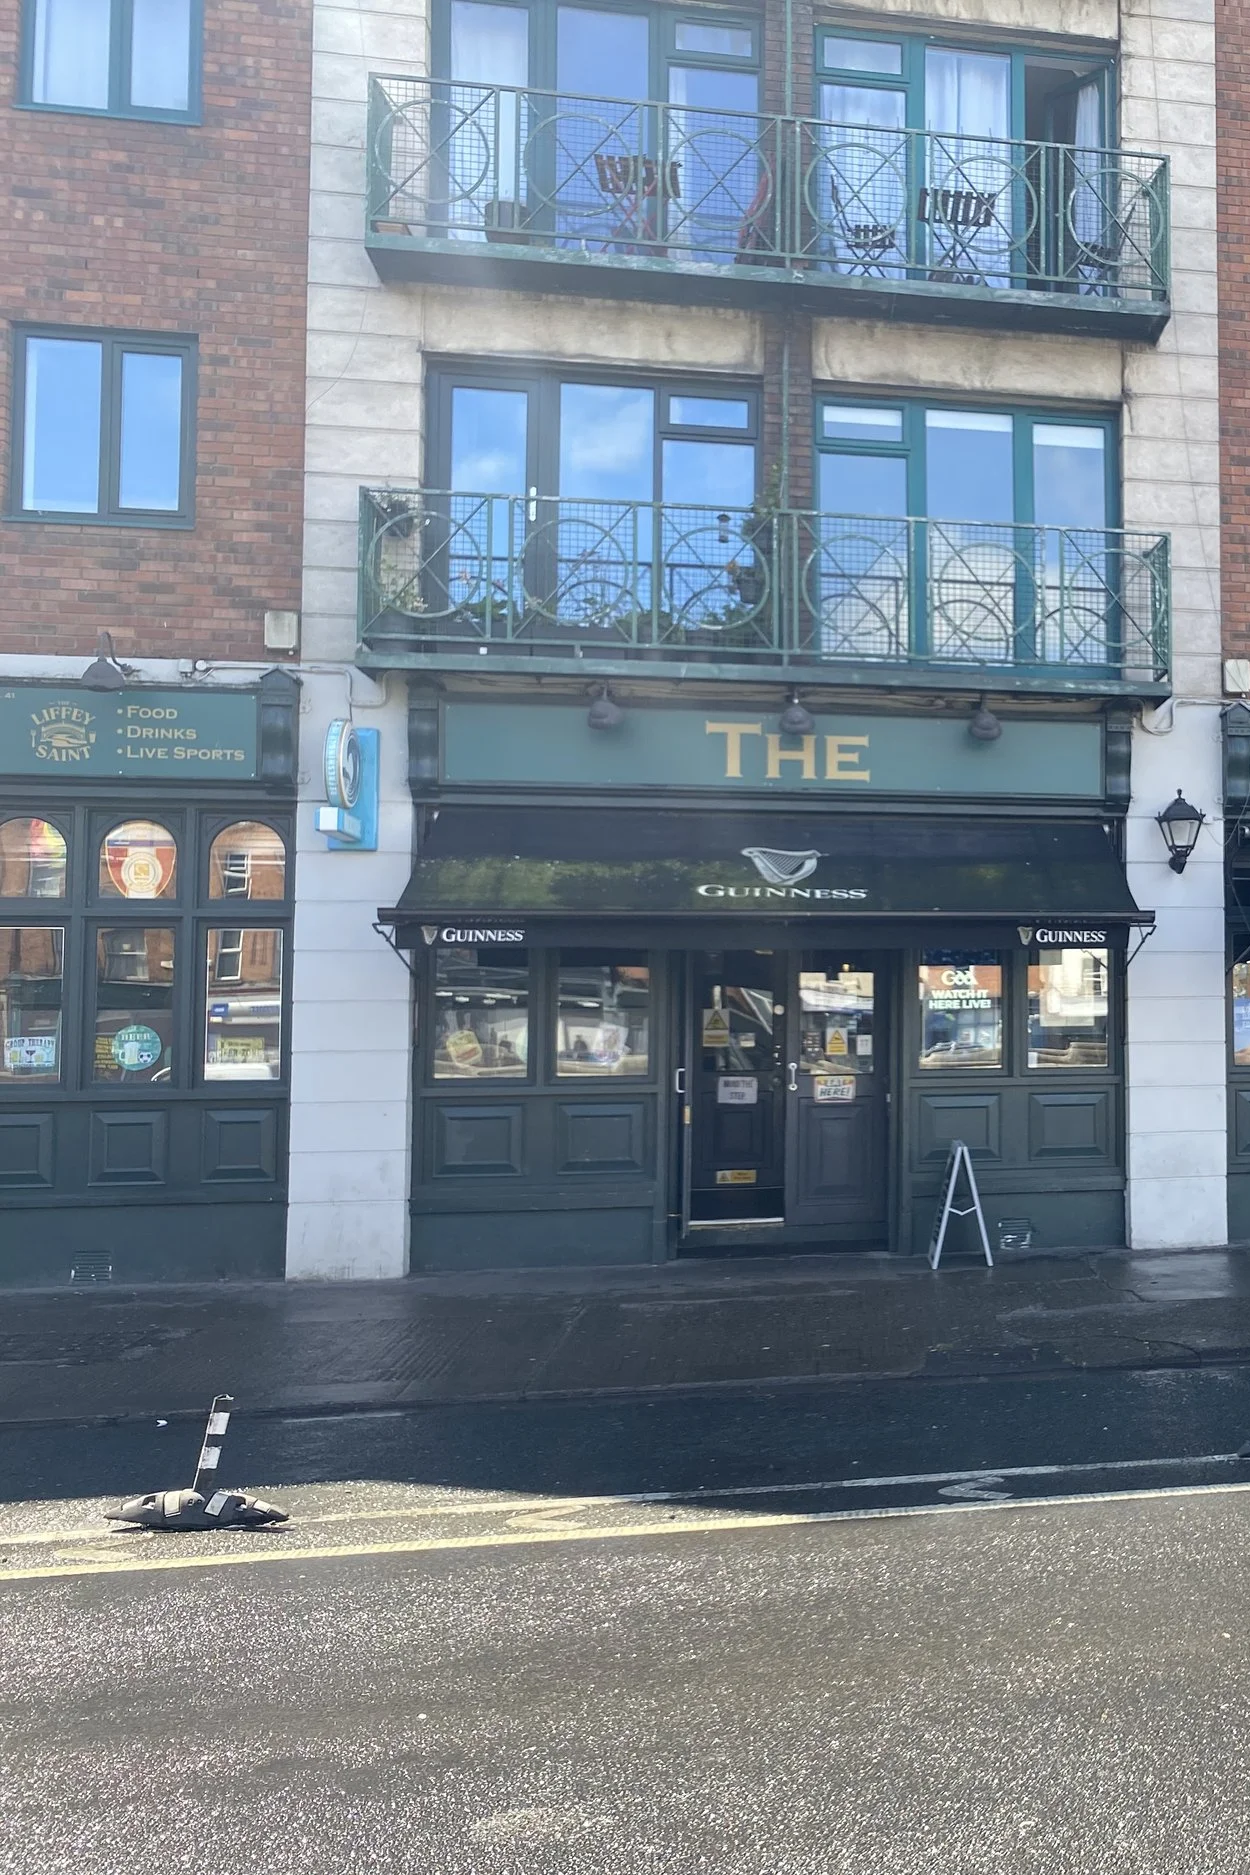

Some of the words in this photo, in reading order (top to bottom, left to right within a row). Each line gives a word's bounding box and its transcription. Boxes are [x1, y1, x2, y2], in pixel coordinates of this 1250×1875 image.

[31, 706, 96, 725] LIFFEY
[127, 705, 178, 720] FOOD
[127, 725, 197, 740] DRINKS
[36, 744, 91, 762] SAINT
[127, 745, 169, 759] LIVE
[174, 747, 245, 761] SPORTS
[705, 720, 870, 783] THE
[695, 884, 869, 900] GUINNESS
[442, 927, 525, 943] GUINNESS
[1035, 928, 1107, 942] GUINNESS
[931, 989, 975, 999] WATCH
[977, 989, 989, 999] IT
[929, 999, 960, 1009] HERE
[962, 999, 992, 1009] LIVE!
[820, 1087, 851, 1097] HERE!
